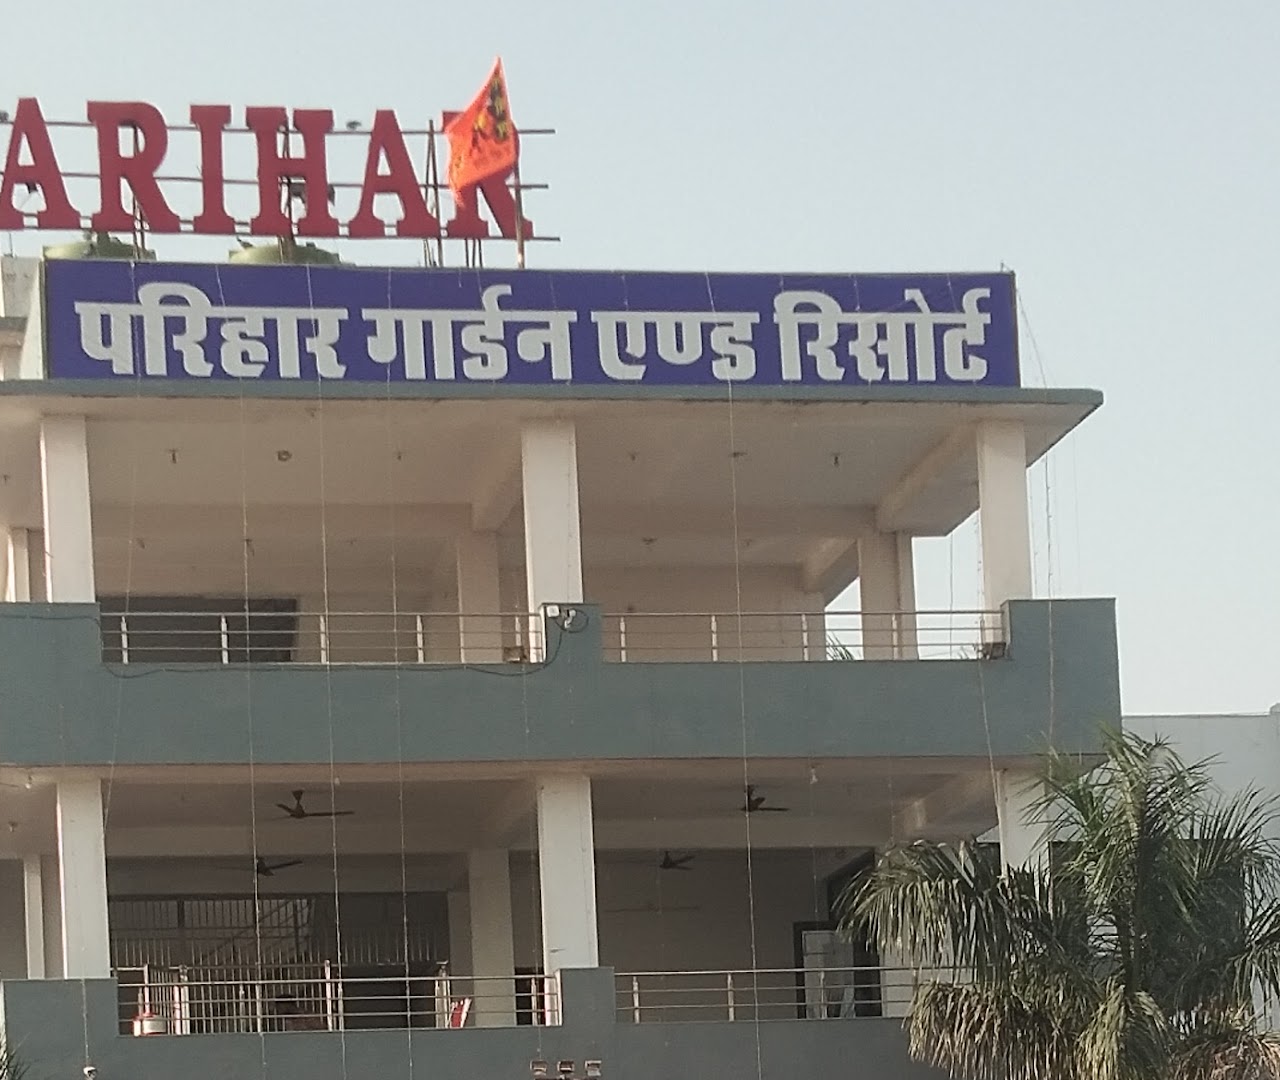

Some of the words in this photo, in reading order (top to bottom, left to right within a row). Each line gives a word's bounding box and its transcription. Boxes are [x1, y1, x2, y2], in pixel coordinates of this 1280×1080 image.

[75, 282, 348, 379] परिहार
[362, 285, 577, 381] गार्डन
[591, 312, 760, 381] एण्ड
[774, 288, 991, 382] रिसोर्ट
